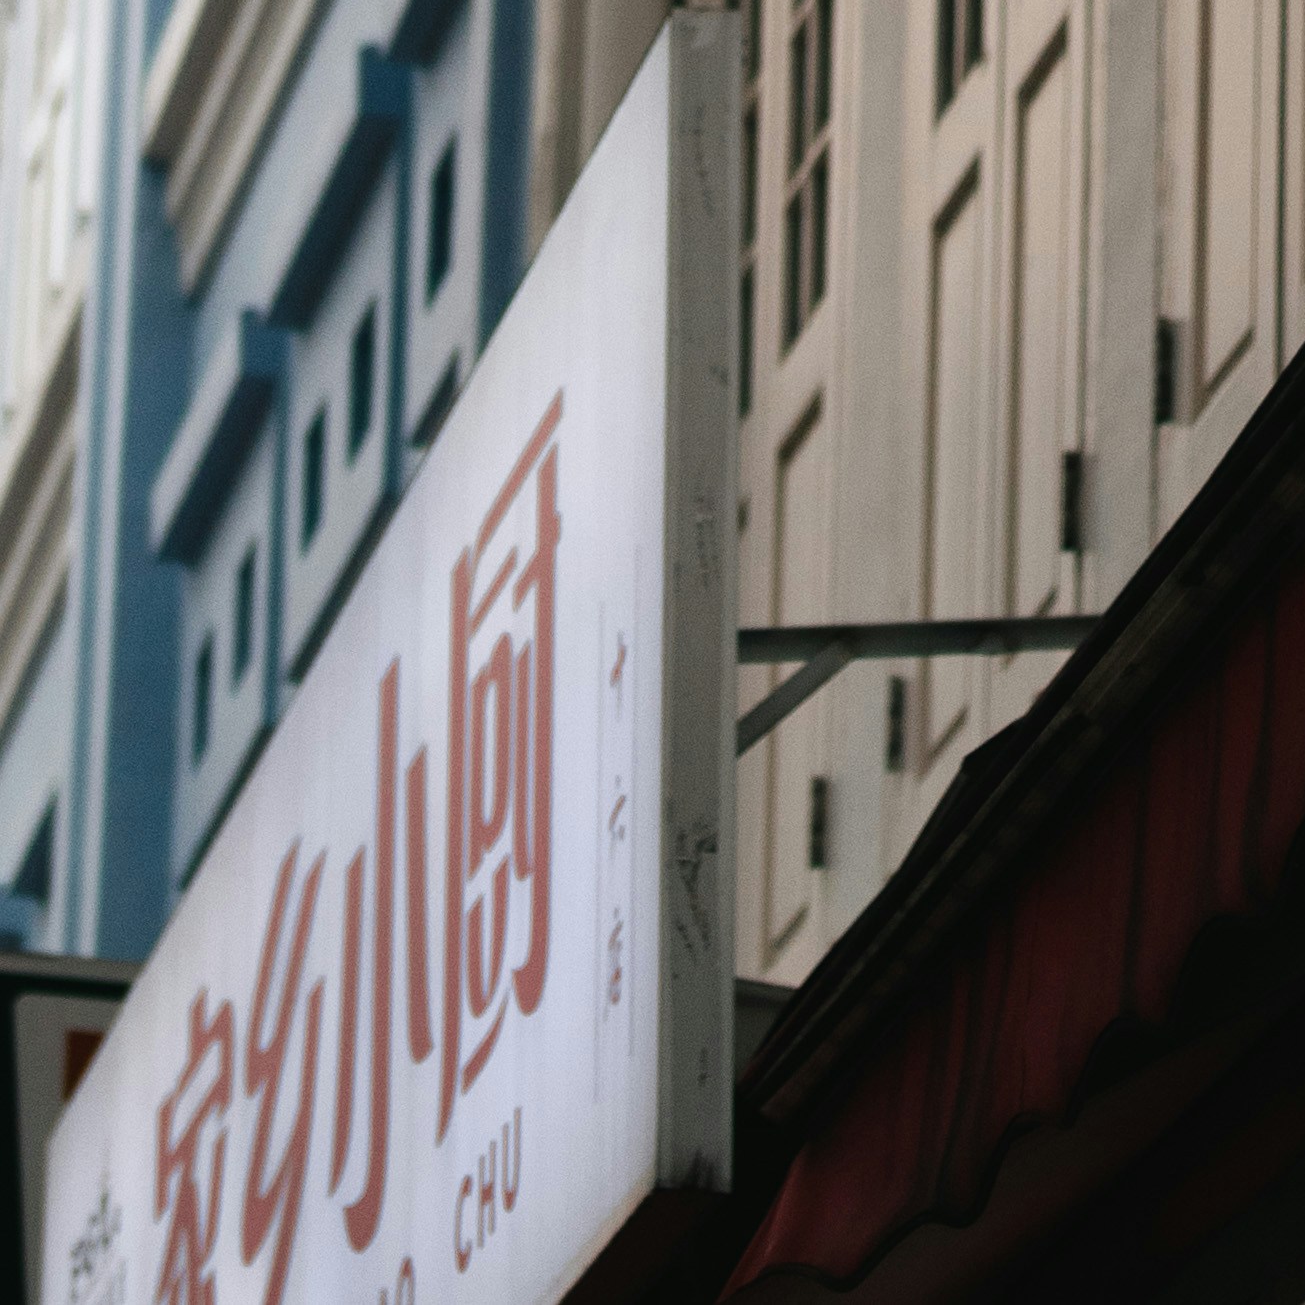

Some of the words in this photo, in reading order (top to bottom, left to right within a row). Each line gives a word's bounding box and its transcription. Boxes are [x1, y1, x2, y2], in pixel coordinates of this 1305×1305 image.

[152, 386, 566, 1305] 家乡小厨
[455, 1105, 523, 1275] CHU
